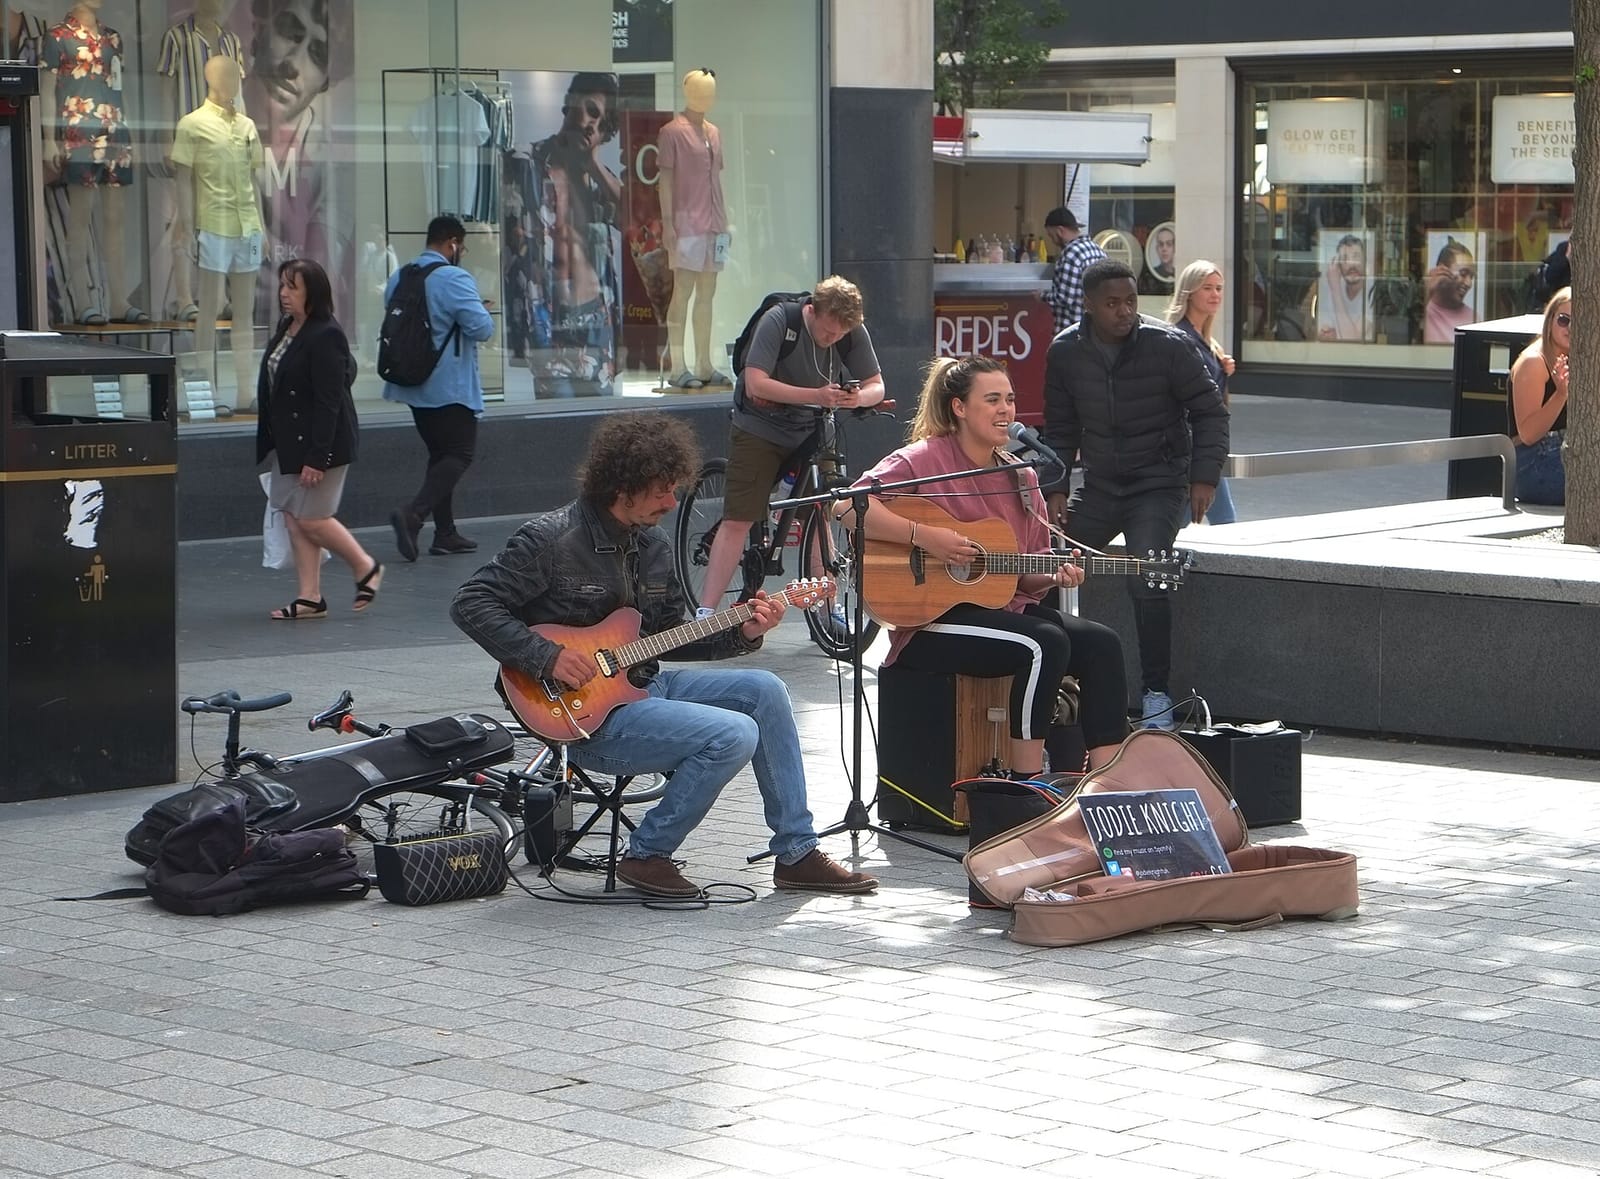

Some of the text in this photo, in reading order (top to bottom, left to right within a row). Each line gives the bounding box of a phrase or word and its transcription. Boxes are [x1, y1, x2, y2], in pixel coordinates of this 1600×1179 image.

[612, 11, 628, 27] SH
[613, 28, 628, 37] ADE
[1518, 120, 1576, 132] BENEFIT
[1283, 129, 1357, 142] GLOW GET
[1315, 143, 1356, 155] TIGER
[1511, 147, 1574, 158] THE SEL
[935, 310, 1032, 360] REPES
[64, 443, 118, 460] LITTER
[1086, 801, 1206, 842] JODIE KNIGHT
[447, 854, 482, 871] VOX
